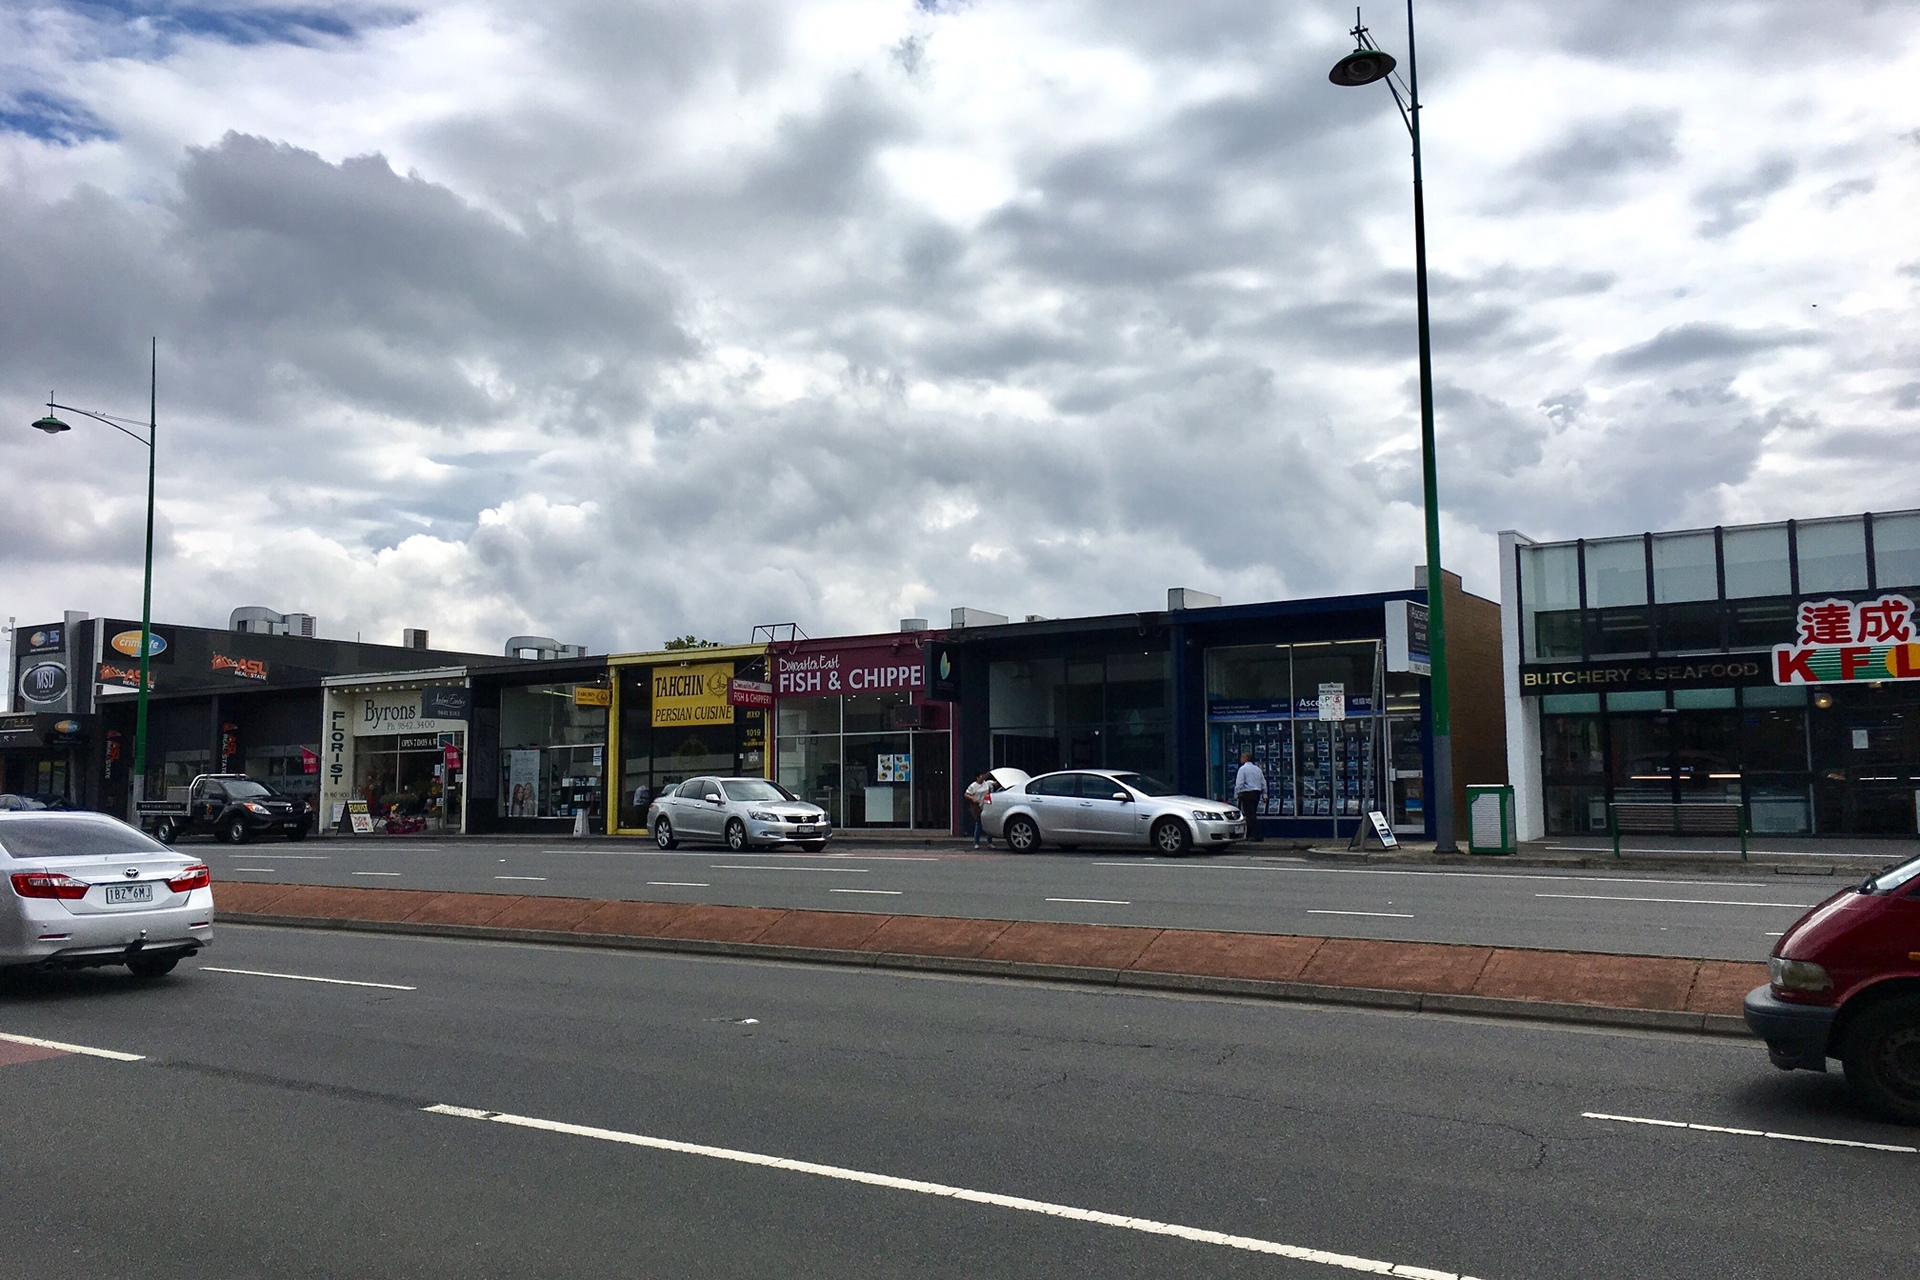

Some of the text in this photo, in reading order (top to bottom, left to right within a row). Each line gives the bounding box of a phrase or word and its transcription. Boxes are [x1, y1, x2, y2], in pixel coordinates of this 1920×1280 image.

[1802, 601, 1910, 645] 達成
[779, 654, 840, 672] Doncaster East
[1523, 662, 1760, 687] BUTCHERY & SEAFOOD
[655, 675, 704, 697] TAHCHIN
[780, 671, 821, 692] FISH
[828, 671, 841, 690] &
[849, 665, 925, 689] CHIPPE
[364, 699, 416, 729] Byrons
[655, 705, 732, 721] PERSIAN CUISINE
[746, 728, 761, 737] 1019
[331, 711, 345, 785] FLORIST
[132, 886, 152, 899] 6MJ
